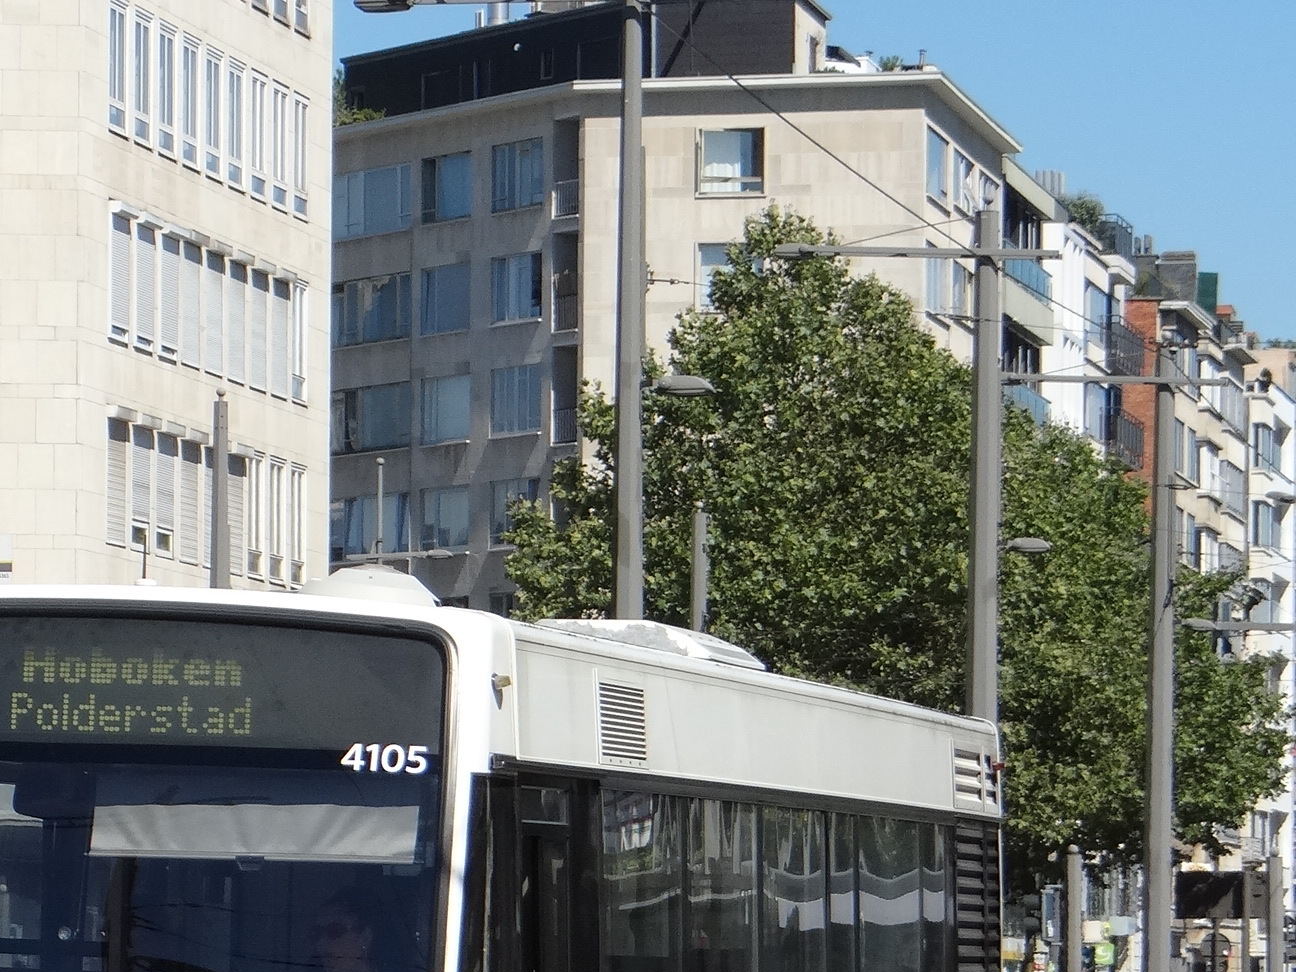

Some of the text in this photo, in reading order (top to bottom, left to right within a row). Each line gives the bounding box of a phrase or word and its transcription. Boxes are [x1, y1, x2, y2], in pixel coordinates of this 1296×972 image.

[23, 646, 242, 687] Hoboken
[10, 691, 252, 735] Polderstad
[340, 743, 428, 774] 4105
